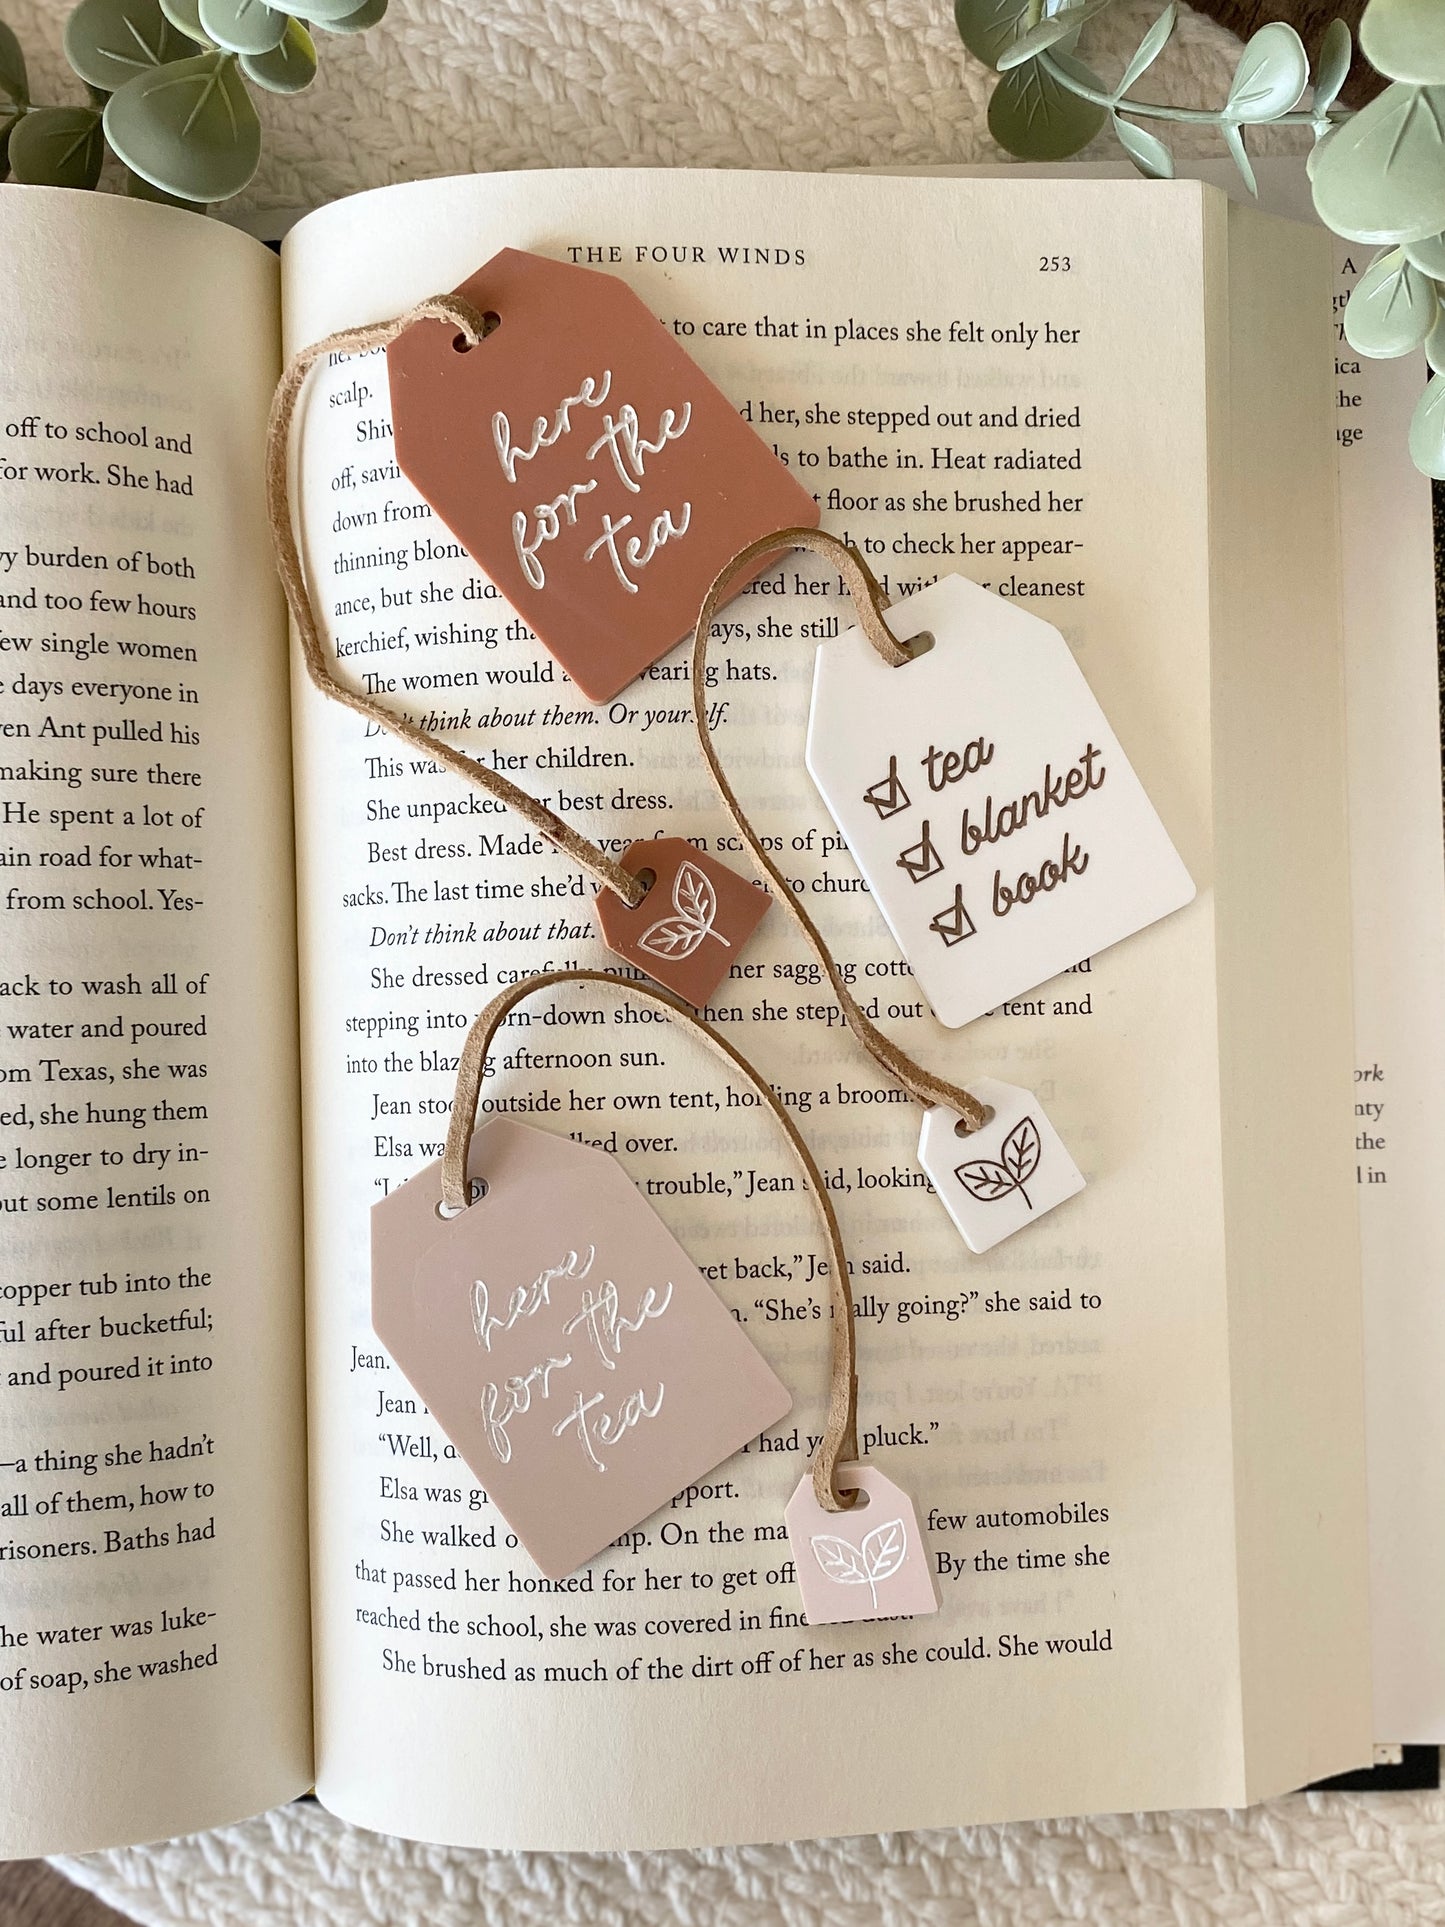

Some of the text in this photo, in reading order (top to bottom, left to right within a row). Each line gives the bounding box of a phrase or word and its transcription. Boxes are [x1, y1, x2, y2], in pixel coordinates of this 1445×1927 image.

[567, 246, 805, 266] THE FOUR WINDS
[1039, 256, 1071, 272] 253
[1341, 257, 1357, 275] A
[672, 315, 1081, 351] to care that in places she felt only her
[329, 381, 373, 407] scalp.
[491, 369, 612, 483] here
[759, 400, 1081, 434] her, she stepped out and dried
[5, 416, 193, 455] off to school and
[797, 444, 1082, 470] to bathe in. Heat radiated
[33, 461, 194, 497] work. She had
[511, 401, 691, 590] for the
[332, 500, 432, 533] down from
[826, 487, 1084, 513] floor as she brushed her
[24, 544, 196, 580] burden of both
[334, 549, 408, 575] thinning
[584, 502, 691, 595] tea
[41, 632, 198, 663] single women
[335, 622, 499, 659] kerchief, wishing
[11, 672, 200, 706] days everyone in
[361, 658, 777, 696] The women would hats.
[477, 706, 537, 729] about
[542, 704, 599, 726] them.
[608, 703, 641, 728] Or
[920, 736, 994, 793] tea
[960, 743, 1106, 856] blanket
[2, 801, 206, 832] He spent a lot of
[39, 844, 203, 870] road for what-
[992, 833, 1090, 917] book
[5, 887, 204, 912] from school. Yes-
[342, 884, 389, 907] sacks.
[391, 881, 428, 903] The
[434, 879, 469, 901] last
[475, 879, 525, 900] time
[424, 921, 477, 945] think
[483, 920, 542, 942] about
[547, 918, 596, 941] that.
[48, 972, 210, 996] to wash all of
[6, 1014, 208, 1045] water and poured
[38, 1057, 208, 1085] Texas, she was
[347, 1046, 665, 1074] into the afternoon sun.
[371, 1088, 720, 1121] Jean outside her own tent,
[1368, 1166, 1387, 1184] in
[36, 1183, 211, 1212] some lentils on
[469, 1244, 596, 1352] here
[985, 1290, 1021, 1313] she
[1029, 1287, 1073, 1311] said
[1079, 1293, 1102, 1310] to
[34, 1306, 213, 1342] after bucketful;
[480, 1280, 673, 1465] for the
[552, 1382, 665, 1473] tea
[758, 1427, 801, 1454] had
[34, 1448, 99, 1476] thing
[104, 1443, 143, 1467] she
[927, 1500, 1109, 1531] few automobiles
[103, 1516, 216, 1554] Baths had
[934, 1543, 1110, 1581] By the time she
[356, 1606, 762, 1642] reached the school, she was covered in
[0, 1643, 219, 1695] of soap, she washed
